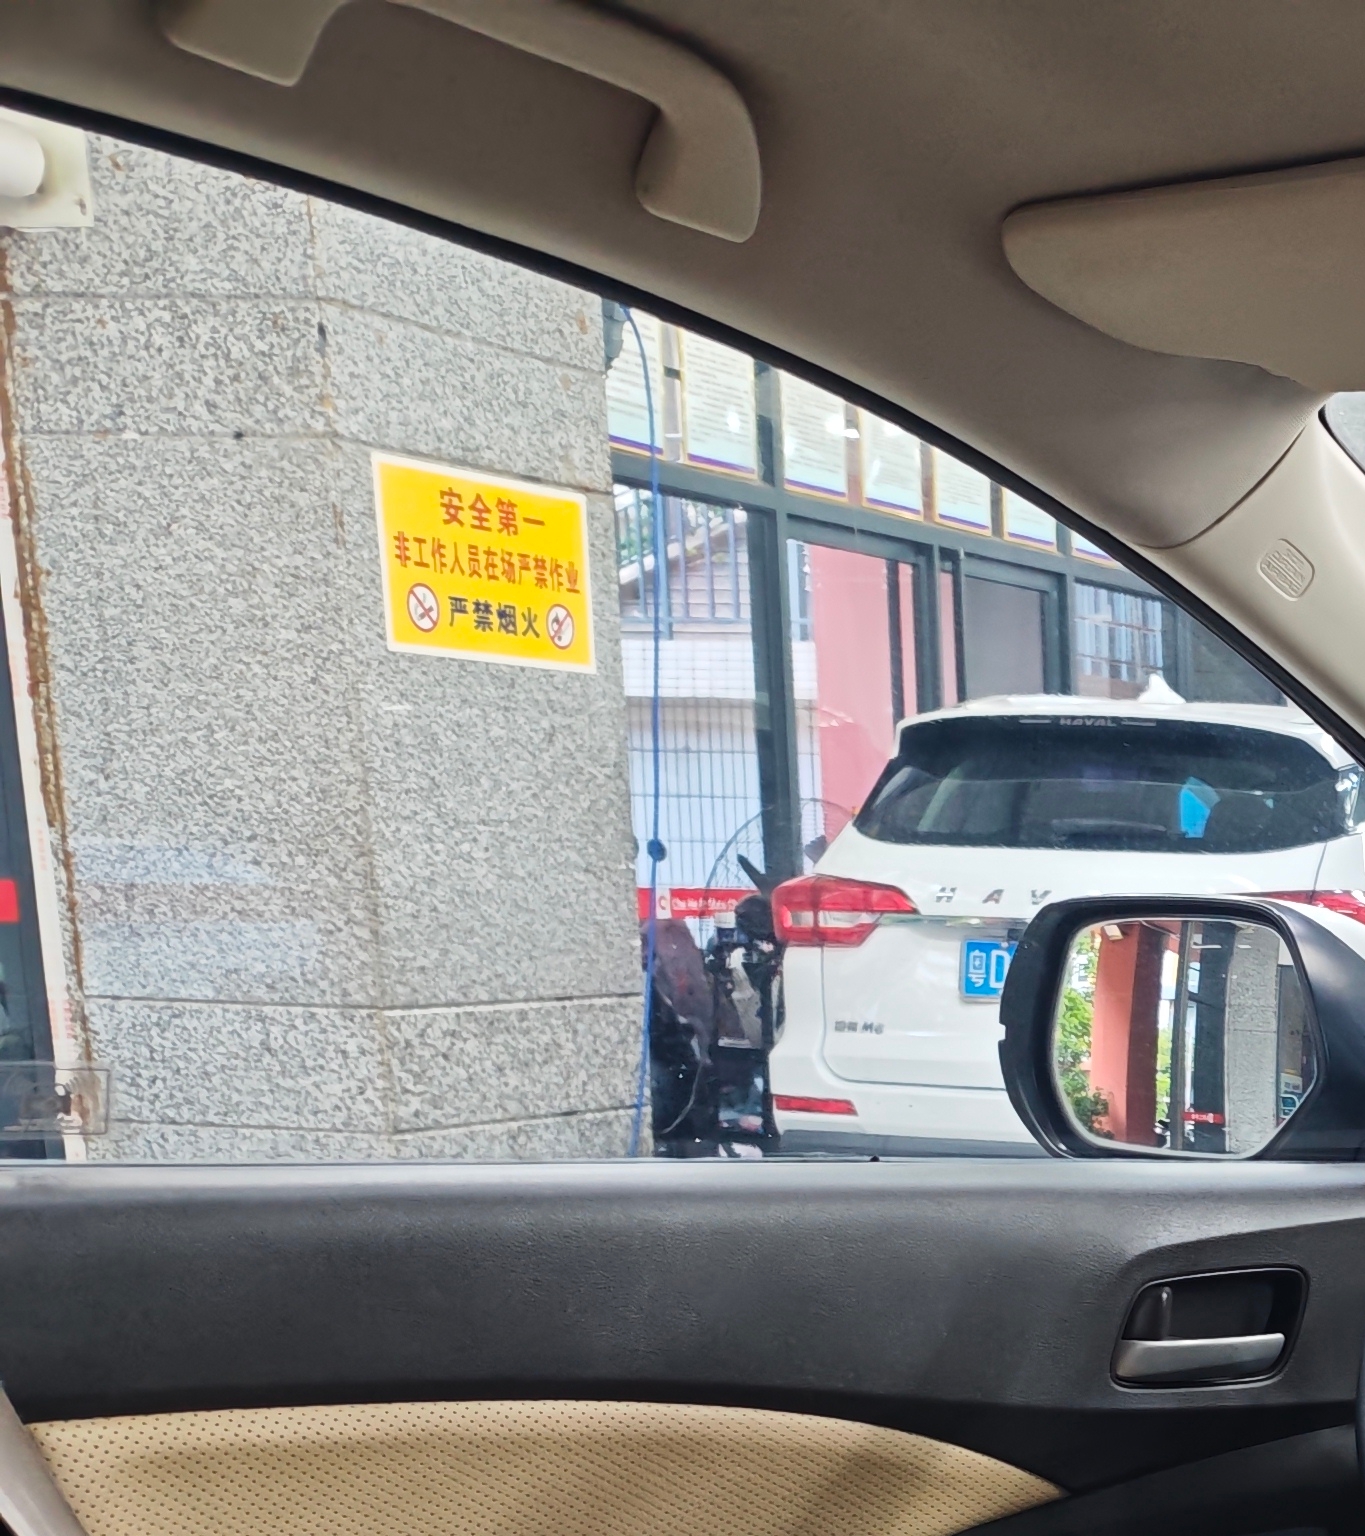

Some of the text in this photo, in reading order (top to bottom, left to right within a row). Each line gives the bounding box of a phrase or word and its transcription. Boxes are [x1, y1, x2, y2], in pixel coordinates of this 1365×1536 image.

[439, 487, 546, 536] 安全第一
[393, 531, 581, 595] 非工作人员在场严禁作业
[448, 595, 541, 639] 严禁烟火
[1060, 717, 1117, 727] HAVAL
